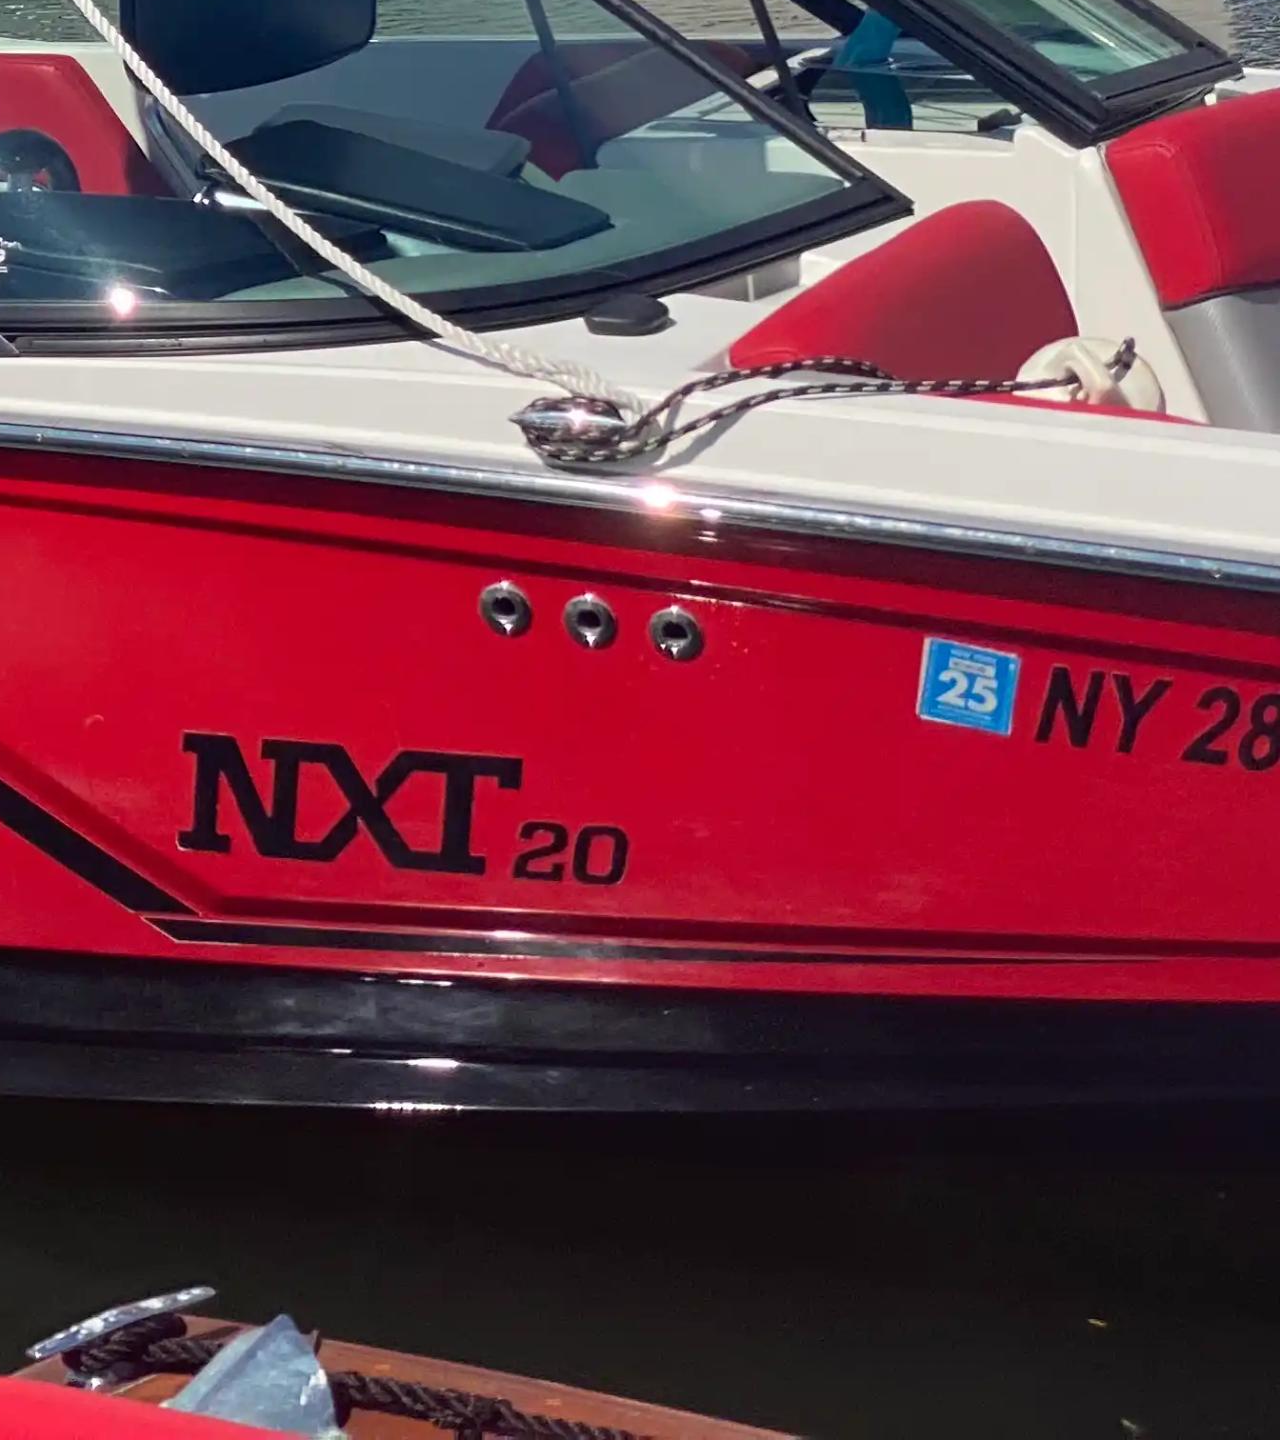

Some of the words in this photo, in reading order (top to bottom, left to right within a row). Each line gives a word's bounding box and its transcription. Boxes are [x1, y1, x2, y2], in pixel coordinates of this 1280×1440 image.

[936, 669, 998, 714] 25
[1034, 663, 1174, 755] NY
[1180, 686, 1280, 772] 28
[176, 730, 523, 876] NXT
[512, 820, 630, 886] 20
